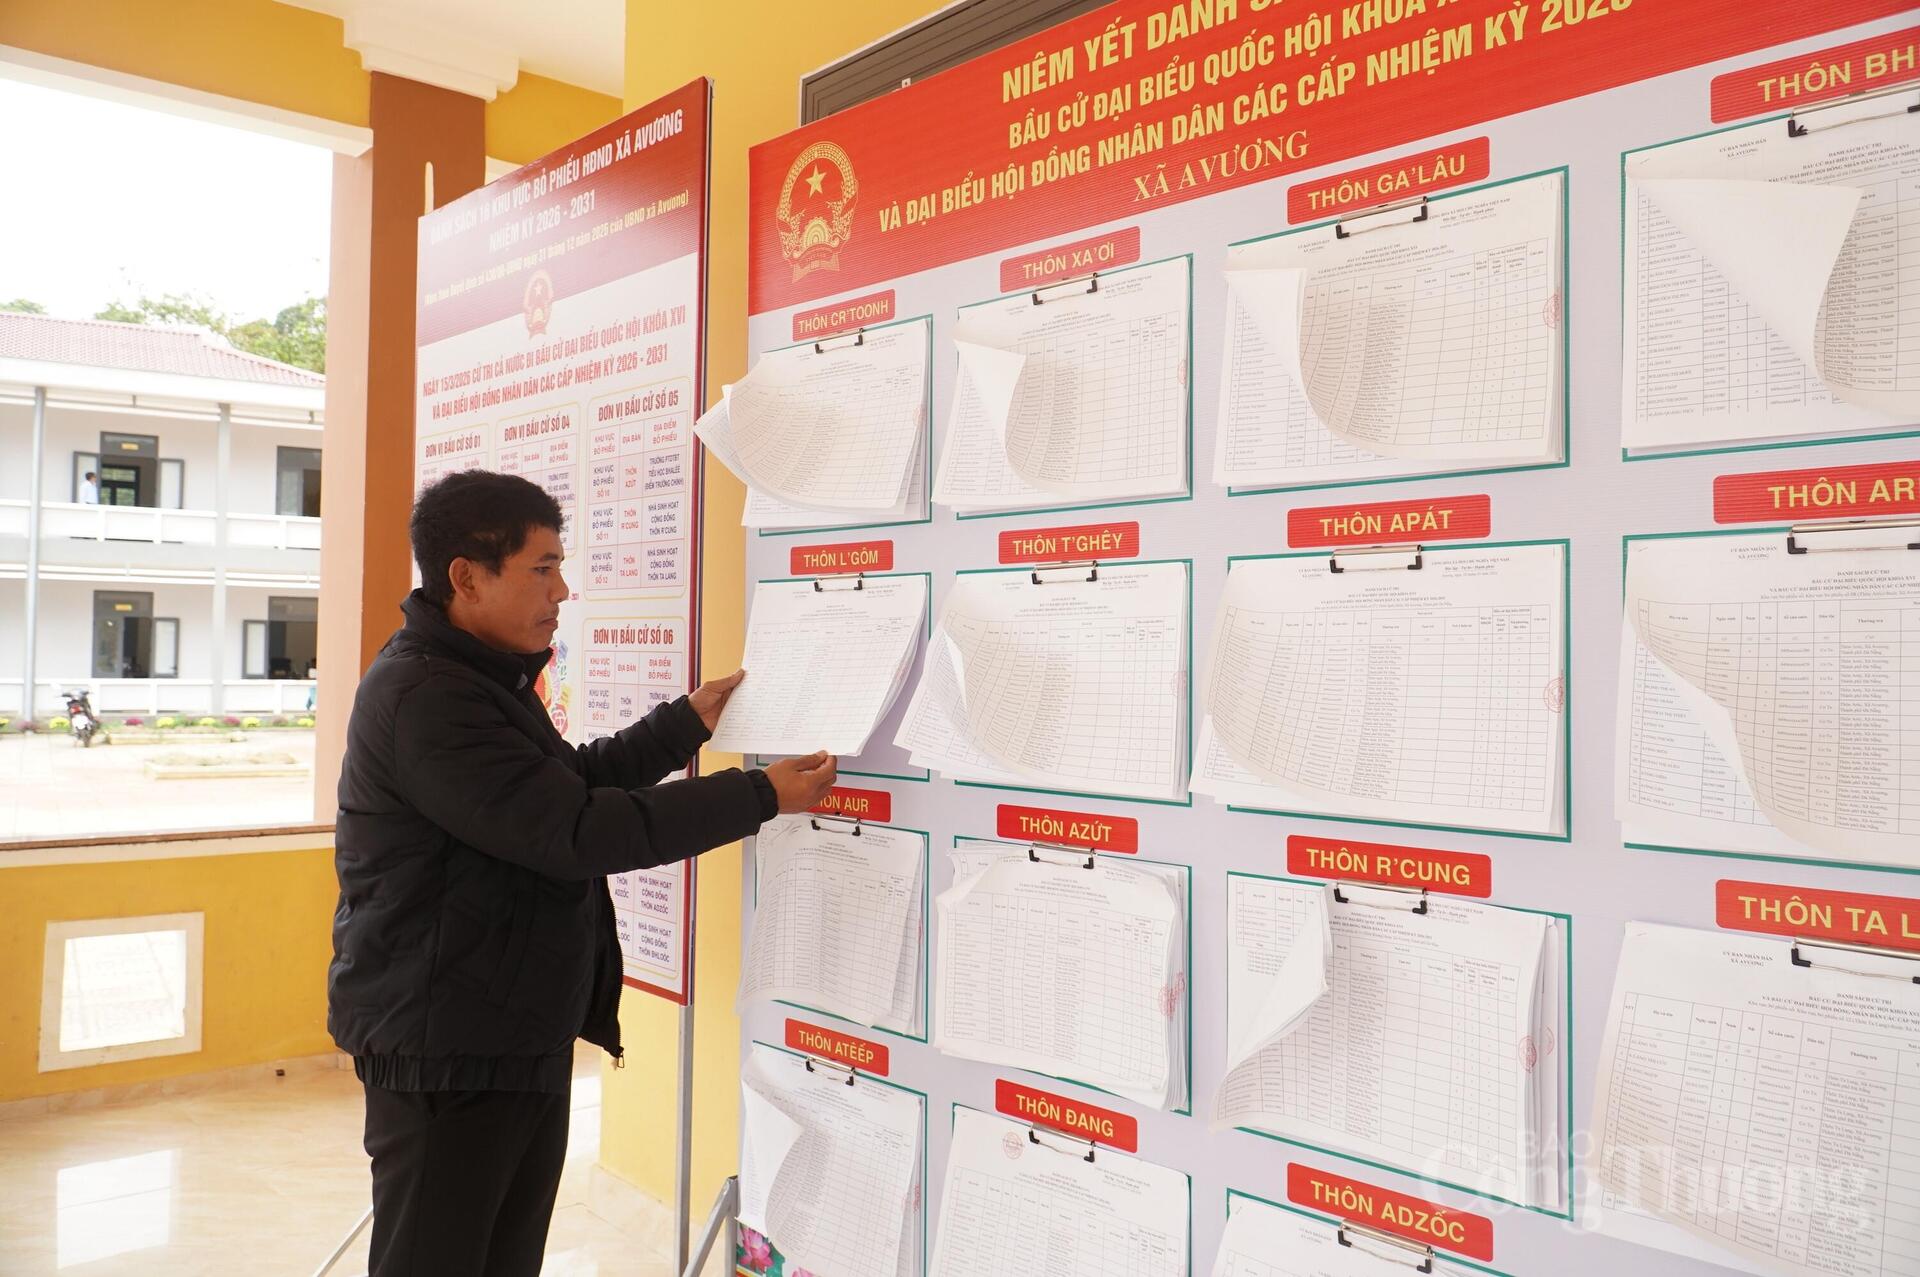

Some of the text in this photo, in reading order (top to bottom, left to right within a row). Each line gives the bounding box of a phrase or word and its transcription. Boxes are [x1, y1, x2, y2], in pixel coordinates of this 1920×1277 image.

[1002, 0, 1238, 104] NIÊM YẾT DANH
[1009, 107, 1050, 149] BẦU
[1057, 90, 1091, 133] CỬ
[1094, 82, 1131, 121] ĐẠI
[1139, 55, 1195, 106] BIỂU
[1203, 28, 1275, 85] QUỐC
[1284, 14, 1332, 58] HỘI
[1758, 44, 1920, 103] THÔN BH
[879, 202, 902, 232] VÀ
[906, 192, 936, 225] ĐẠI
[942, 169, 985, 214] BIỂU
[991, 163, 1025, 199] HỘI
[1031, 145, 1091, 187] ĐỒNG
[1098, 119, 1164, 167] NHÂN
[1172, 103, 1224, 144] DÂN
[1233, 81, 1288, 125] CÁC
[1297, 55, 1356, 106] CẤP
[1366, 22, 1472, 86] NHIỆM
[1485, 1, 1529, 50] KỲ
[512, 181, 531, 209] VỰC
[533, 167, 547, 199] BỎ
[549, 154, 580, 192] PHIẾU
[582, 143, 613, 177] HĐND
[615, 130, 631, 162] XÃ
[634, 109, 683, 153] AVƯƠNG
[1134, 130, 1309, 201] XÃ AVƯƠNG
[1308, 153, 1465, 210] THÔN GA'LÂU
[536, 204, 561, 233] 2026
[570, 189, 596, 219] 2031
[1022, 254, 1066, 280] THÔN
[580, 325, 599, 354] BIỂU
[600, 319, 624, 349] QUỐC
[625, 316, 641, 342] HỘI
[643, 308, 668, 335] KHÓA
[670, 304, 686, 327] XVI
[798, 299, 889, 334] THÔN CR'TOONH
[482, 385, 501, 408] ĐỒNG
[502, 381, 522, 403] NHÂN
[523, 377, 539, 397] DÂN
[540, 371, 556, 393] CÁC
[557, 364, 573, 388] CẤP
[575, 359, 602, 385] NHIỆM
[603, 354, 615, 377] KỲ
[616, 351, 638, 374] 2026
[646, 343, 668, 366] 2031
[551, 410, 561, 431] SỐ
[561, 415, 570, 430] 04
[598, 386, 679, 421] ĐƠN VỊ BẦU CỬ SỐ 05
[1767, 476, 1920, 509] THÔN AR
[1319, 505, 1453, 537] THÔN APÁT
[803, 547, 879, 567] THÔN L'GÔM
[1013, 528, 1123, 556] THÔN T'GHÊY
[594, 623, 674, 647] ĐƠN VỊ BẦU CỬ SỐ 06
[820, 794, 869, 813] ÔN AUR
[1019, 815, 1112, 842] THÔN AZỨT
[1306, 847, 1470, 886] THÔN R'CUNG
[1738, 895, 1920, 940] THÔN TA L
[798, 1030, 874, 1064] THÔN ATÊẾP
[1015, 1094, 1115, 1137] THÔN ĐANG
[1310, 1180, 1465, 1243] THÔN ADZỐC
